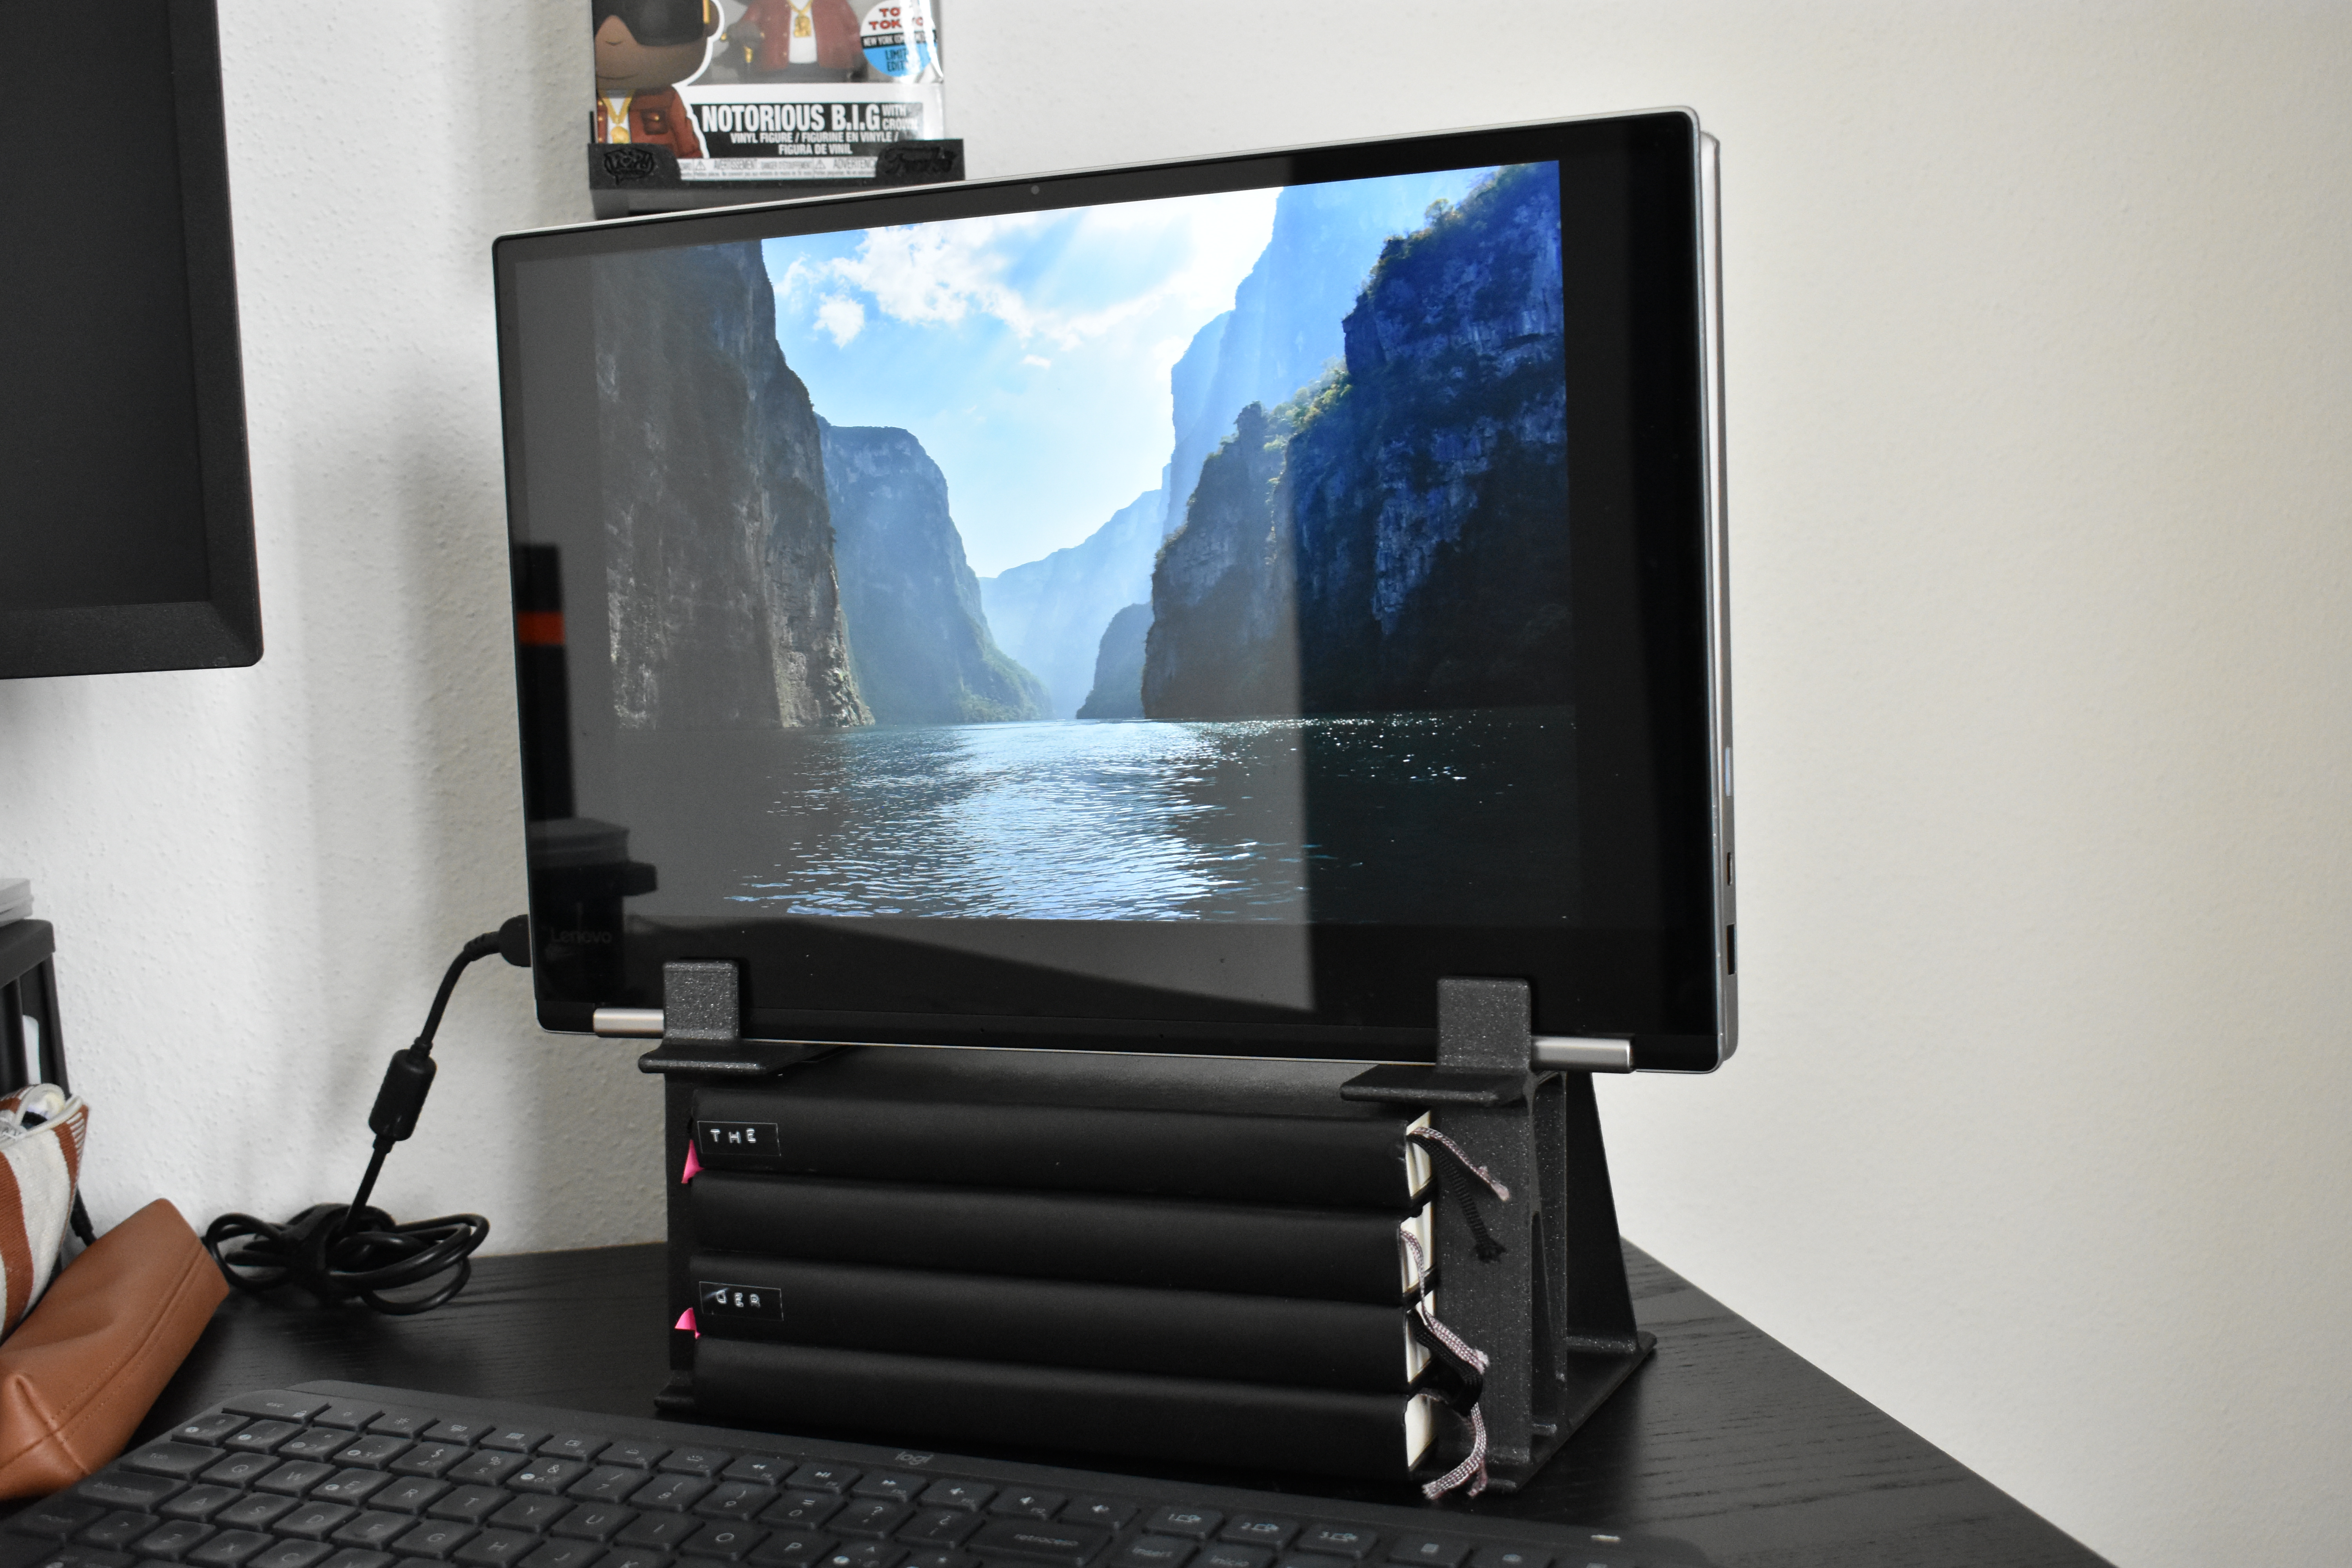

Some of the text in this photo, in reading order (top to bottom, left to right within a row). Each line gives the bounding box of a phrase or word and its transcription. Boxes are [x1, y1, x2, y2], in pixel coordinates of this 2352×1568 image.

[882, 104, 907, 116] WITH
[702, 104, 880, 132] NOTORIOUS B.I.G
[730, 132, 758, 144] VINYL
[760, 132, 793, 143] FIGURE
[801, 131, 843, 143] FIGURINE
[846, 131, 858, 142] EN
[860, 131, 892, 142] VINYLE
[778, 143, 853, 155] FIGURA DE VINIL
[550, 926, 612, 944] Lenovo
[710, 1128, 757, 1144] THE
[895, 1451, 934, 1465] logi
[401, 1489, 419, 1498] R
[585, 1515, 605, 1524] U
[488, 1541, 508, 1552] H
[784, 1542, 802, 1551] P
